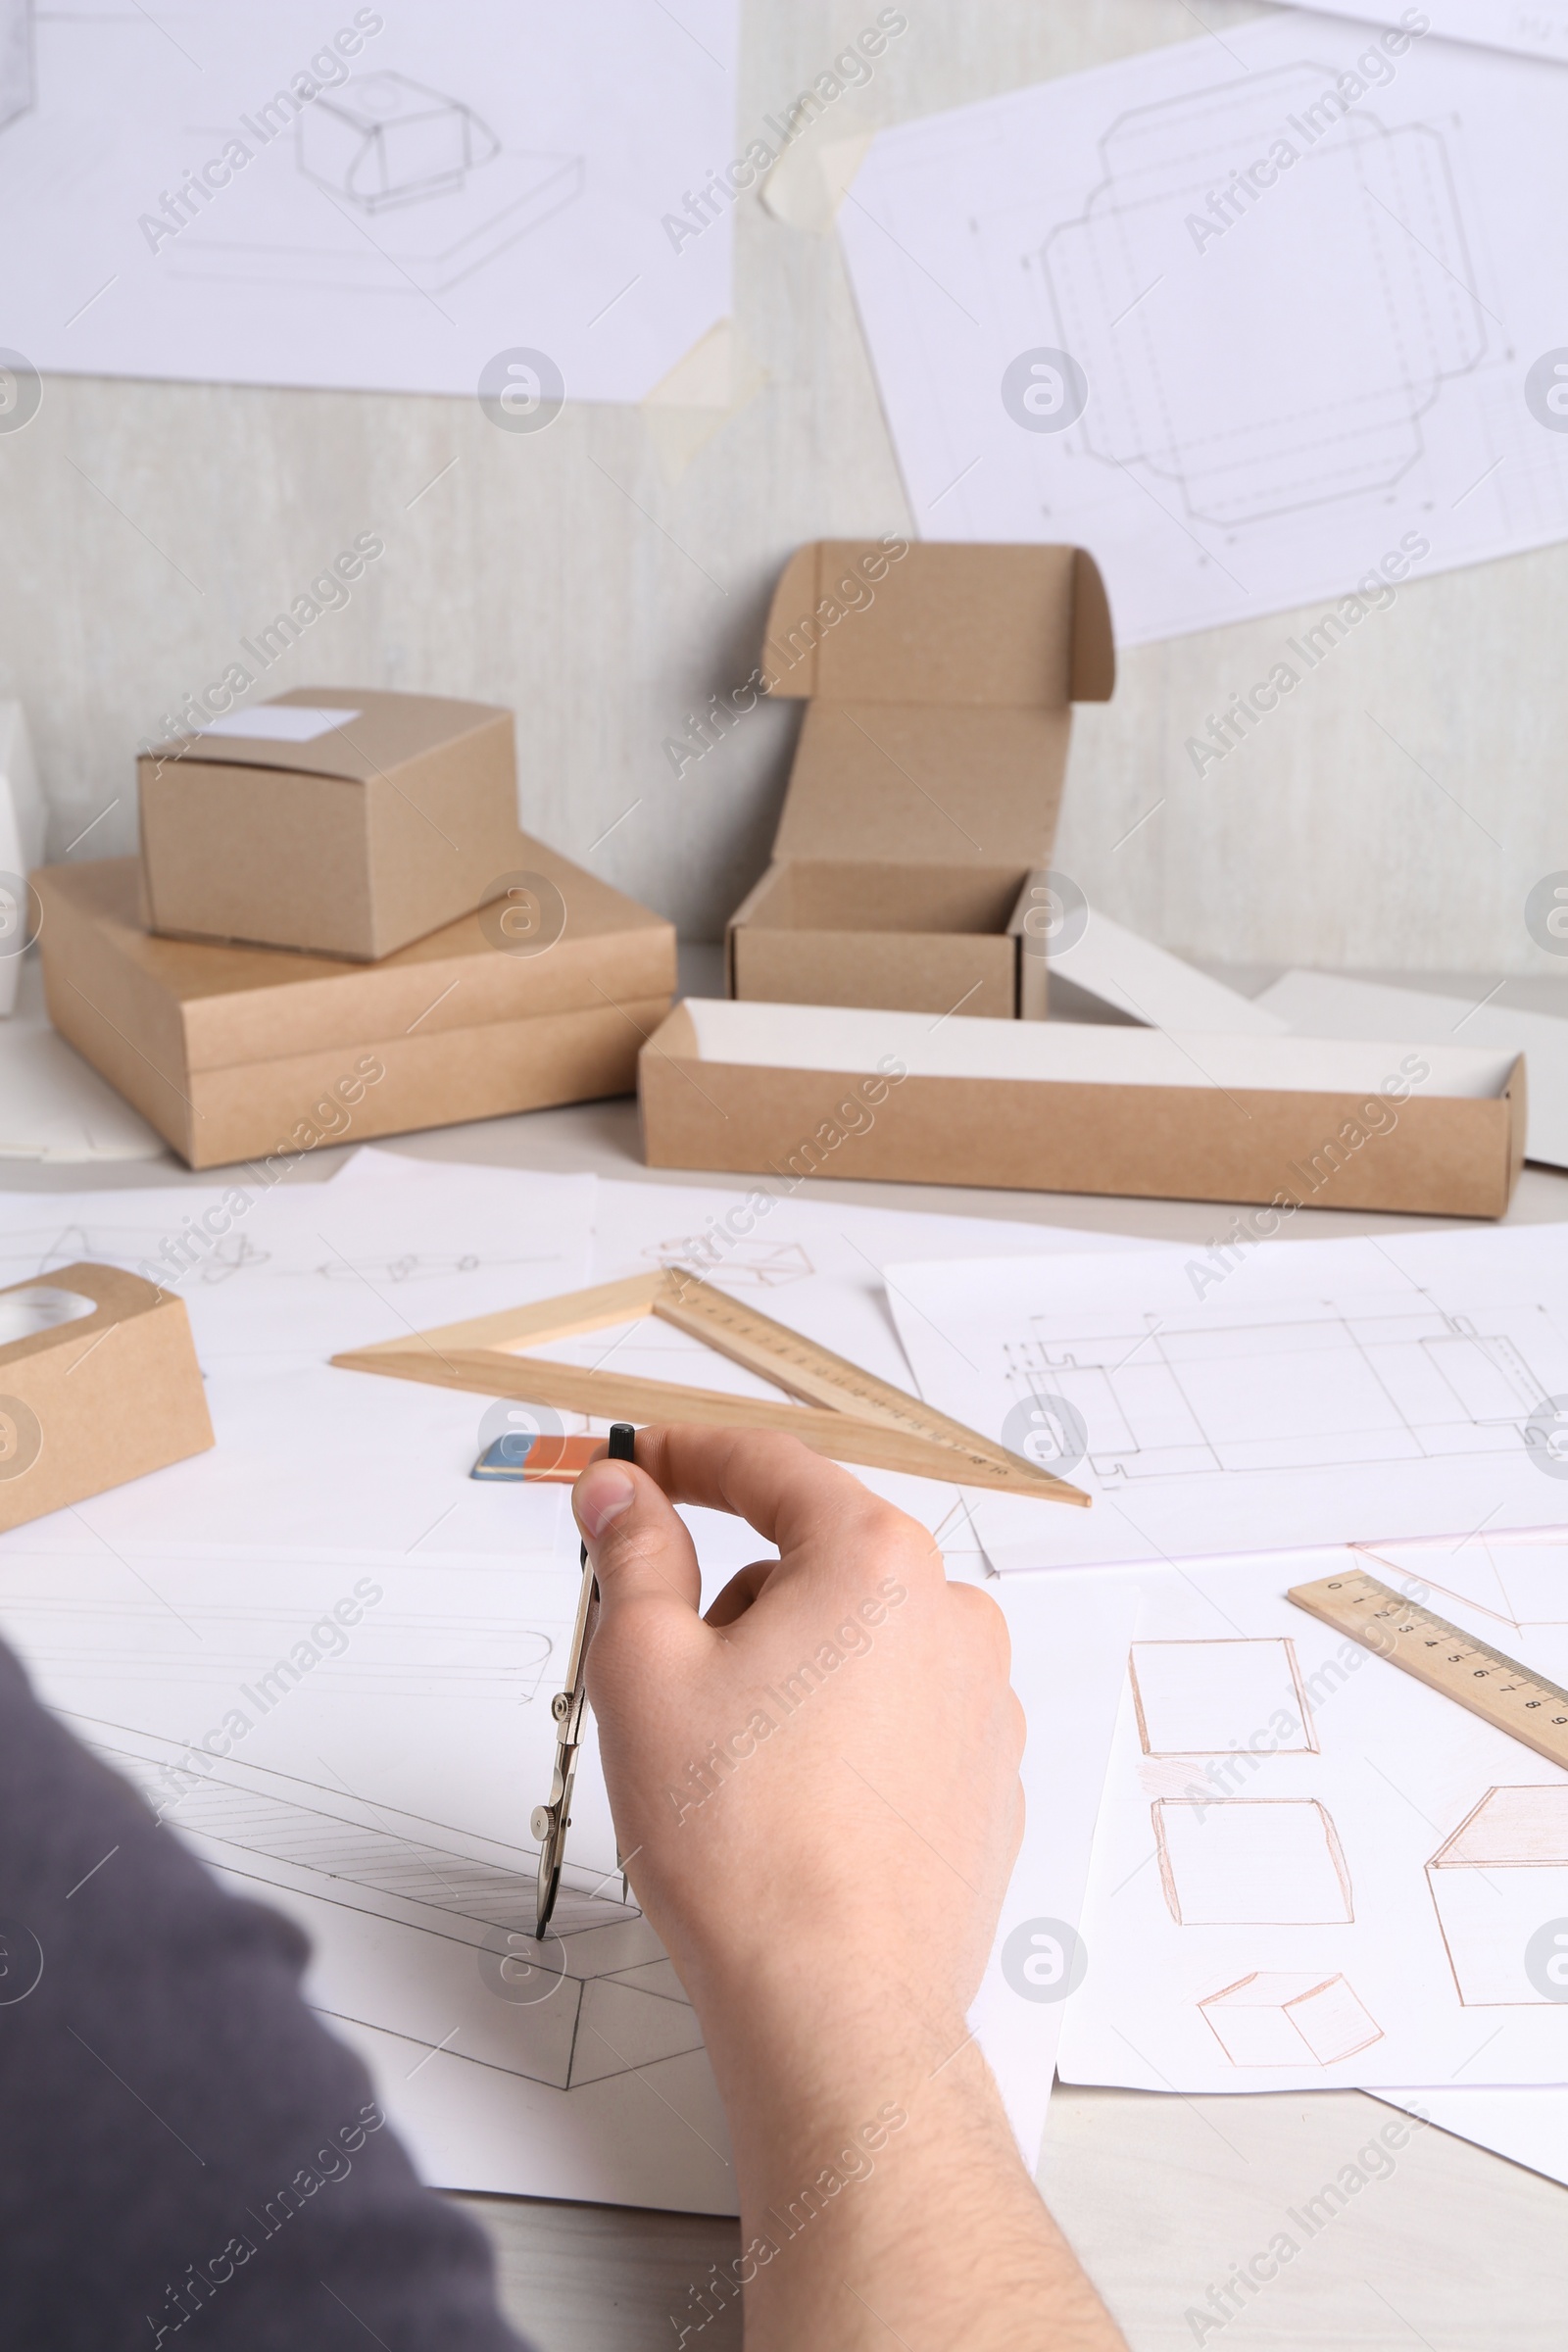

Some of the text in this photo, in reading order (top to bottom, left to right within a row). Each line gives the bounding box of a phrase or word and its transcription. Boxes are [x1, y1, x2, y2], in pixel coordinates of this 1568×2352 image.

[1374, 1610, 1391, 1619] 2
[1397, 1625, 1414, 1634] 3
[1447, 1654, 1465, 1663] 5
[1473, 1669, 1490, 1678] 6
[1525, 1700, 1542, 1709] 8
[1551, 1716, 1568, 1725] 9
